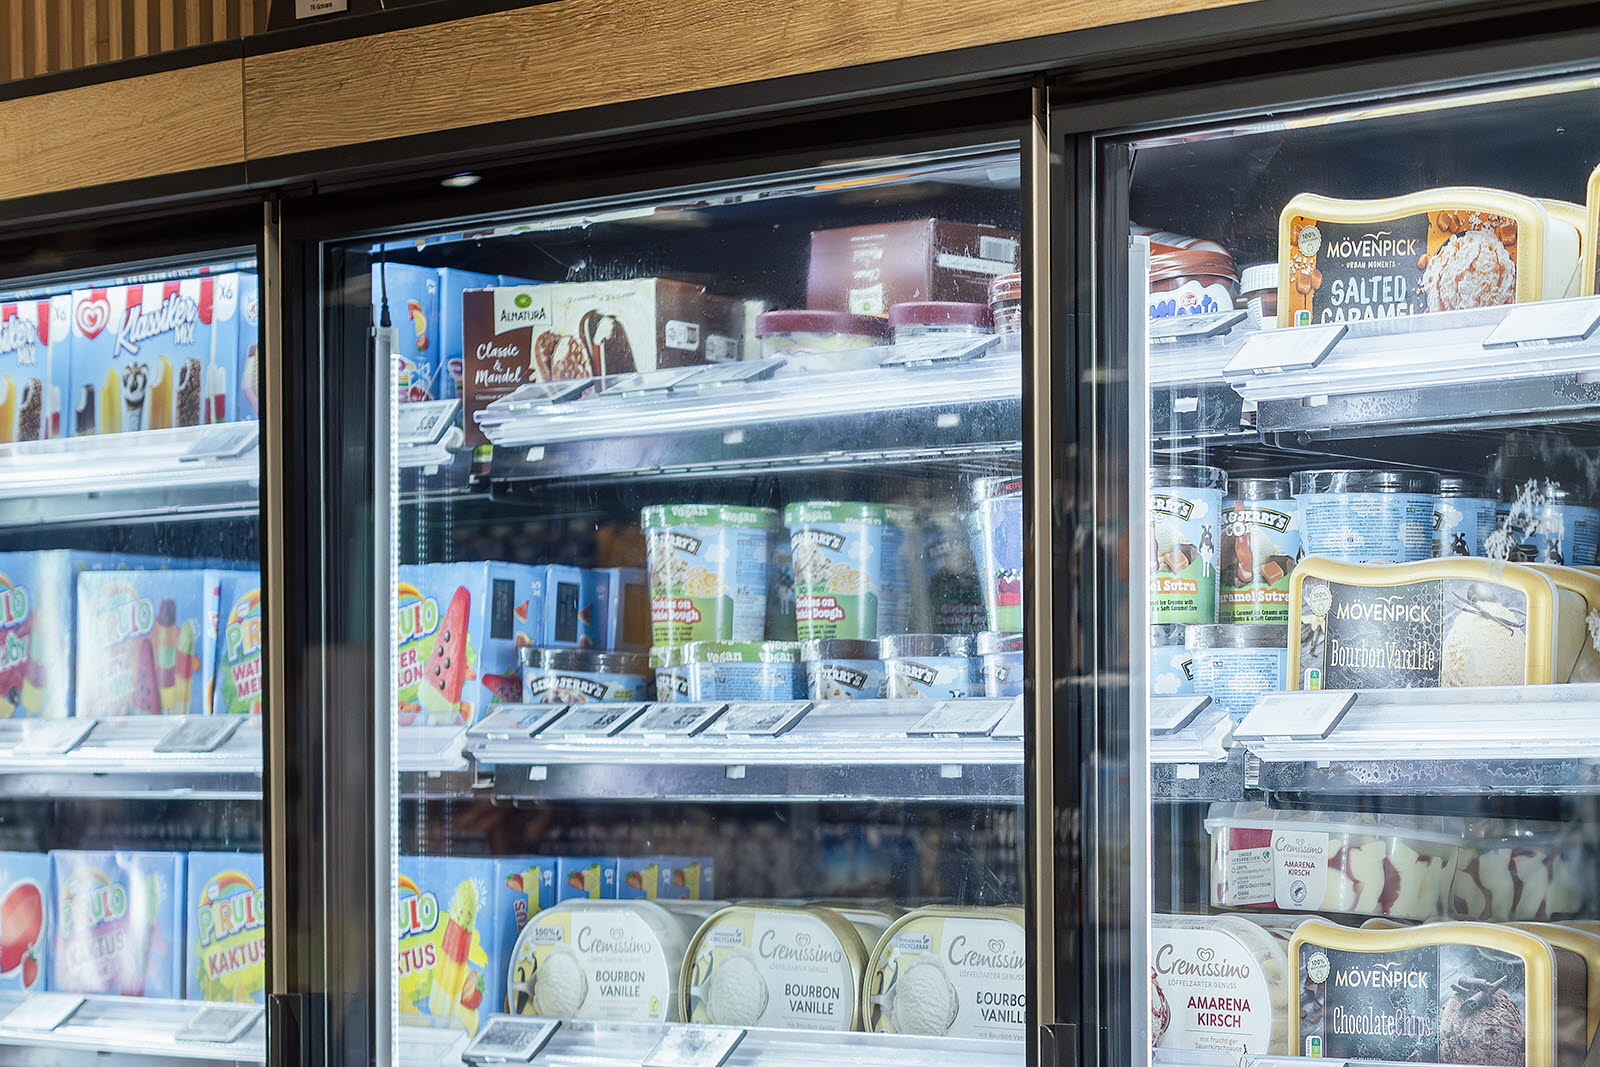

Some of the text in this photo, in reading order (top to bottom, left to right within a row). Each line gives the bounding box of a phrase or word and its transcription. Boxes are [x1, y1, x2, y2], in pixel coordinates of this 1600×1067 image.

[1327, 236, 1417, 258] MÖVENPICK
[1331, 275, 1407, 306] SALTED
[113, 292, 199, 356] Klassiker
[174, 322, 195, 345] MIX
[476, 343, 519, 361] Classic
[475, 367, 522, 386] Mandel
[1163, 580, 1197, 592] Sutra
[669, 609, 701, 622] Dough
[812, 607, 844, 621] Dough
[1337, 597, 1431, 623] MÖVENPICK
[707, 651, 743, 662] Vegan
[1284, 860, 1316, 869] AMARENA
[1287, 869, 1311, 877] KIRSCH
[578, 926, 651, 953] Cremissimo
[758, 929, 842, 964] Cremissimo
[1155, 943, 1250, 981] Cremissimo
[595, 970, 645, 983] BOURBON
[1168, 979, 1237, 990] LÖFFELZARTER GENUSS
[1335, 967, 1429, 989] MÖVENPICK
[599, 985, 641, 998] VANILLE
[784, 983, 840, 1000] BOURBON
[790, 1000, 834, 1015] VANILLE
[1187, 995, 1251, 1013] AMARENA
[1197, 1012, 1242, 1028] KIRSCH
[1210, 1037, 1239, 1046] fruchtiger
